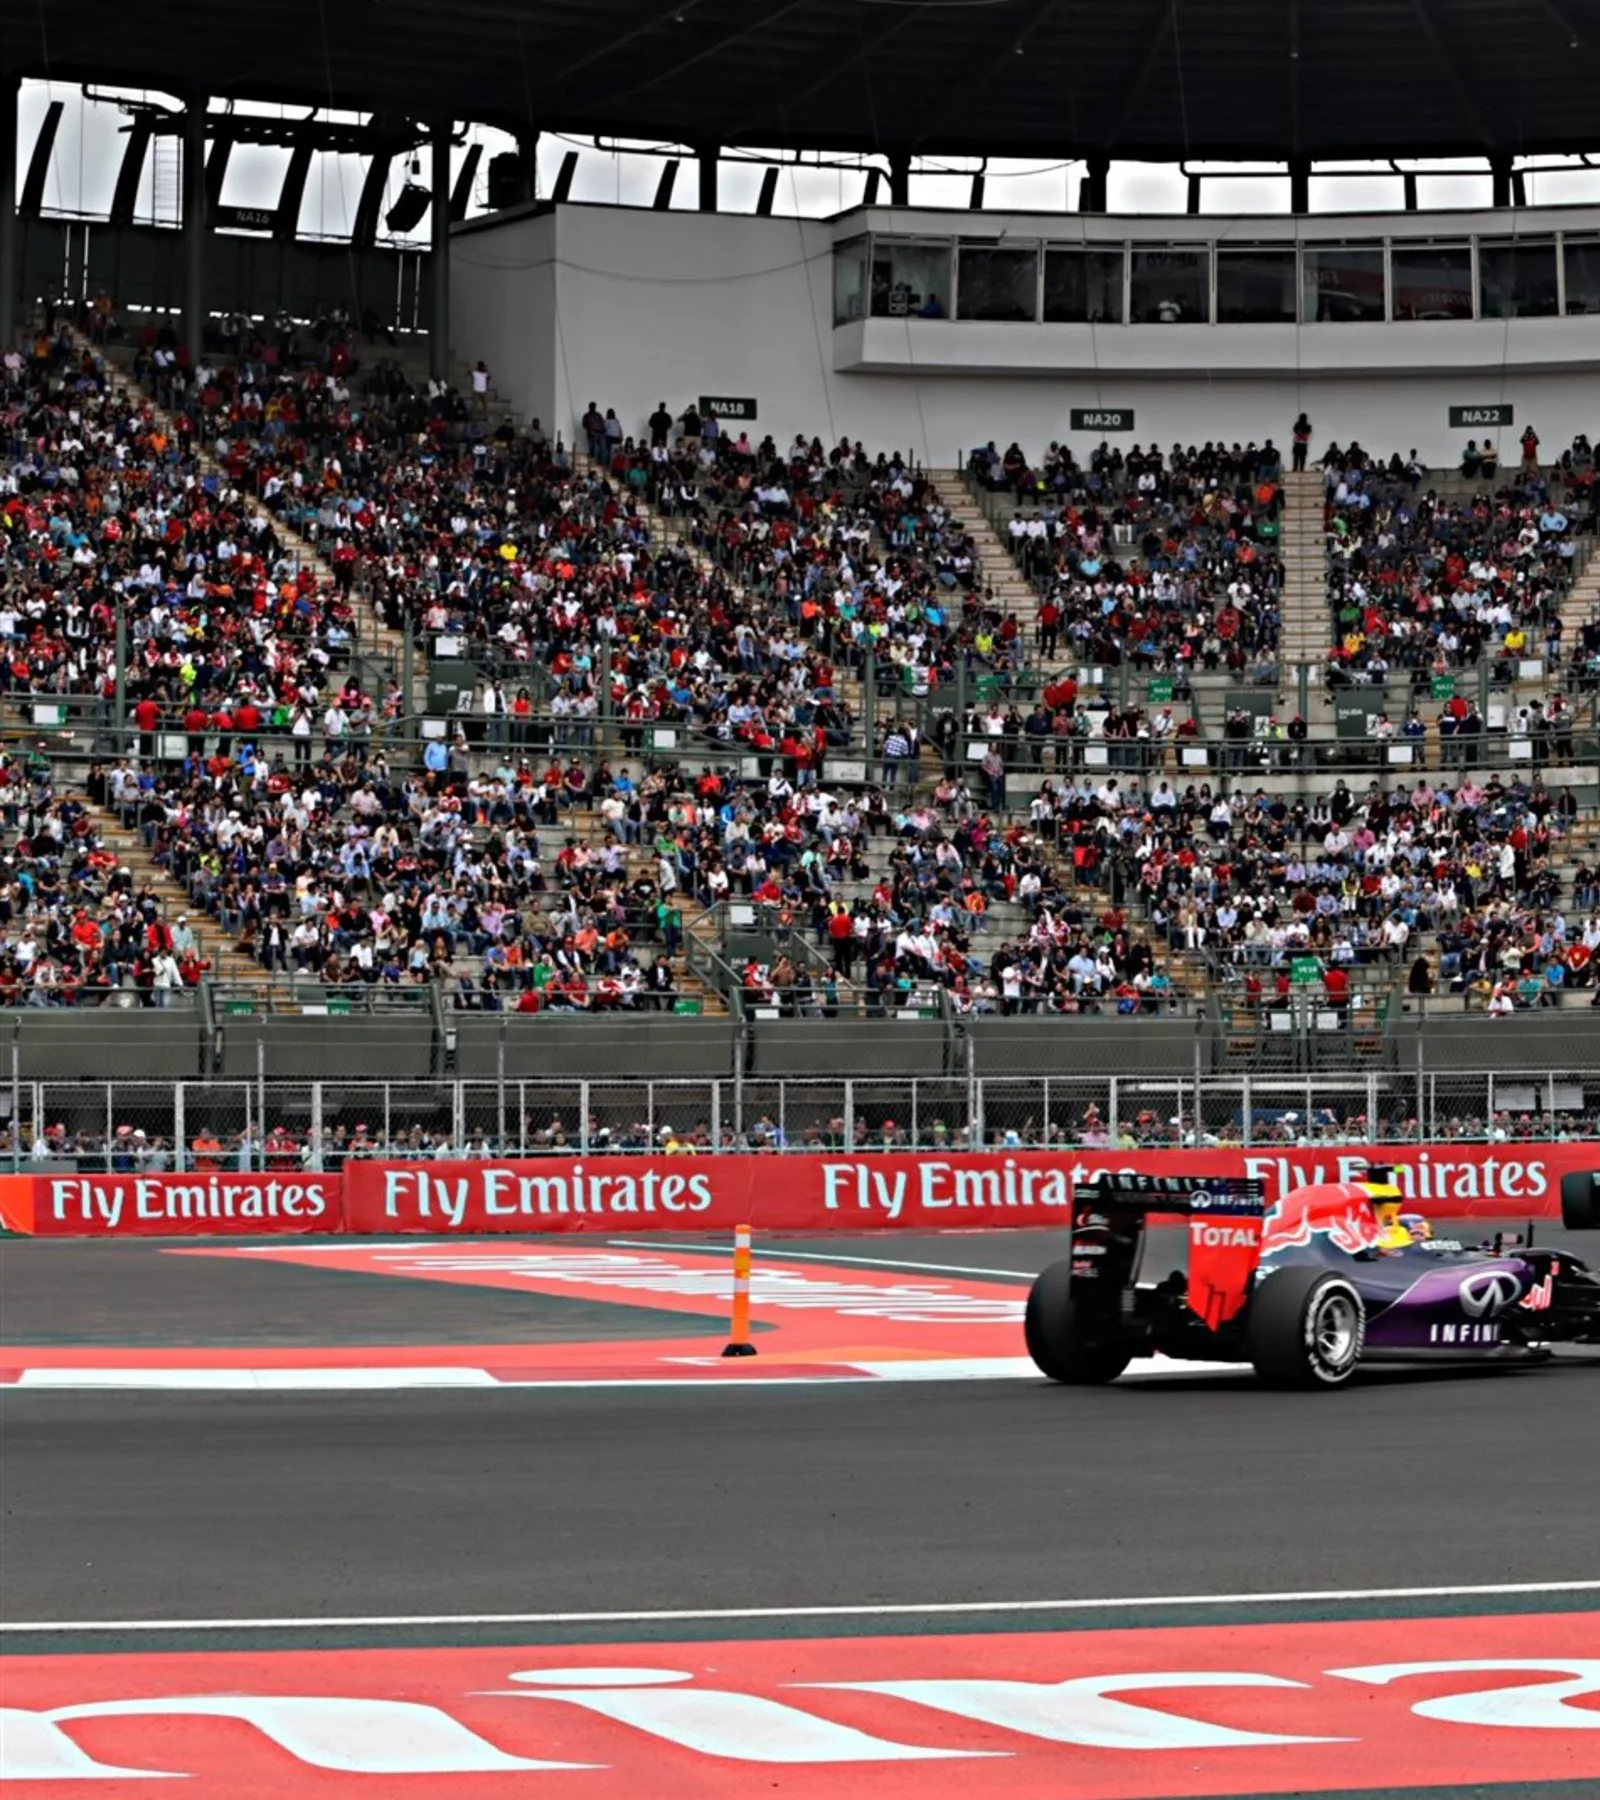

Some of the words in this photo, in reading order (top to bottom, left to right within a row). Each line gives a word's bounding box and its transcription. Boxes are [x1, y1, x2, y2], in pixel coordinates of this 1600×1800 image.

[236, 211, 270, 224] NA16
[710, 401, 745, 415] NA18
[1083, 413, 1121, 426] NA20
[1462, 410, 1500, 423] NA22
[1338, 708, 1363, 716] SALIDA
[385, 1170, 469, 1226] Fly
[483, 1165, 713, 1214] Emirates
[821, 1163, 907, 1219] Fly
[52, 1179, 125, 1228] Fly
[136, 1176, 325, 1219] Emirates
[1190, 1222, 1259, 1247] TOTAL
